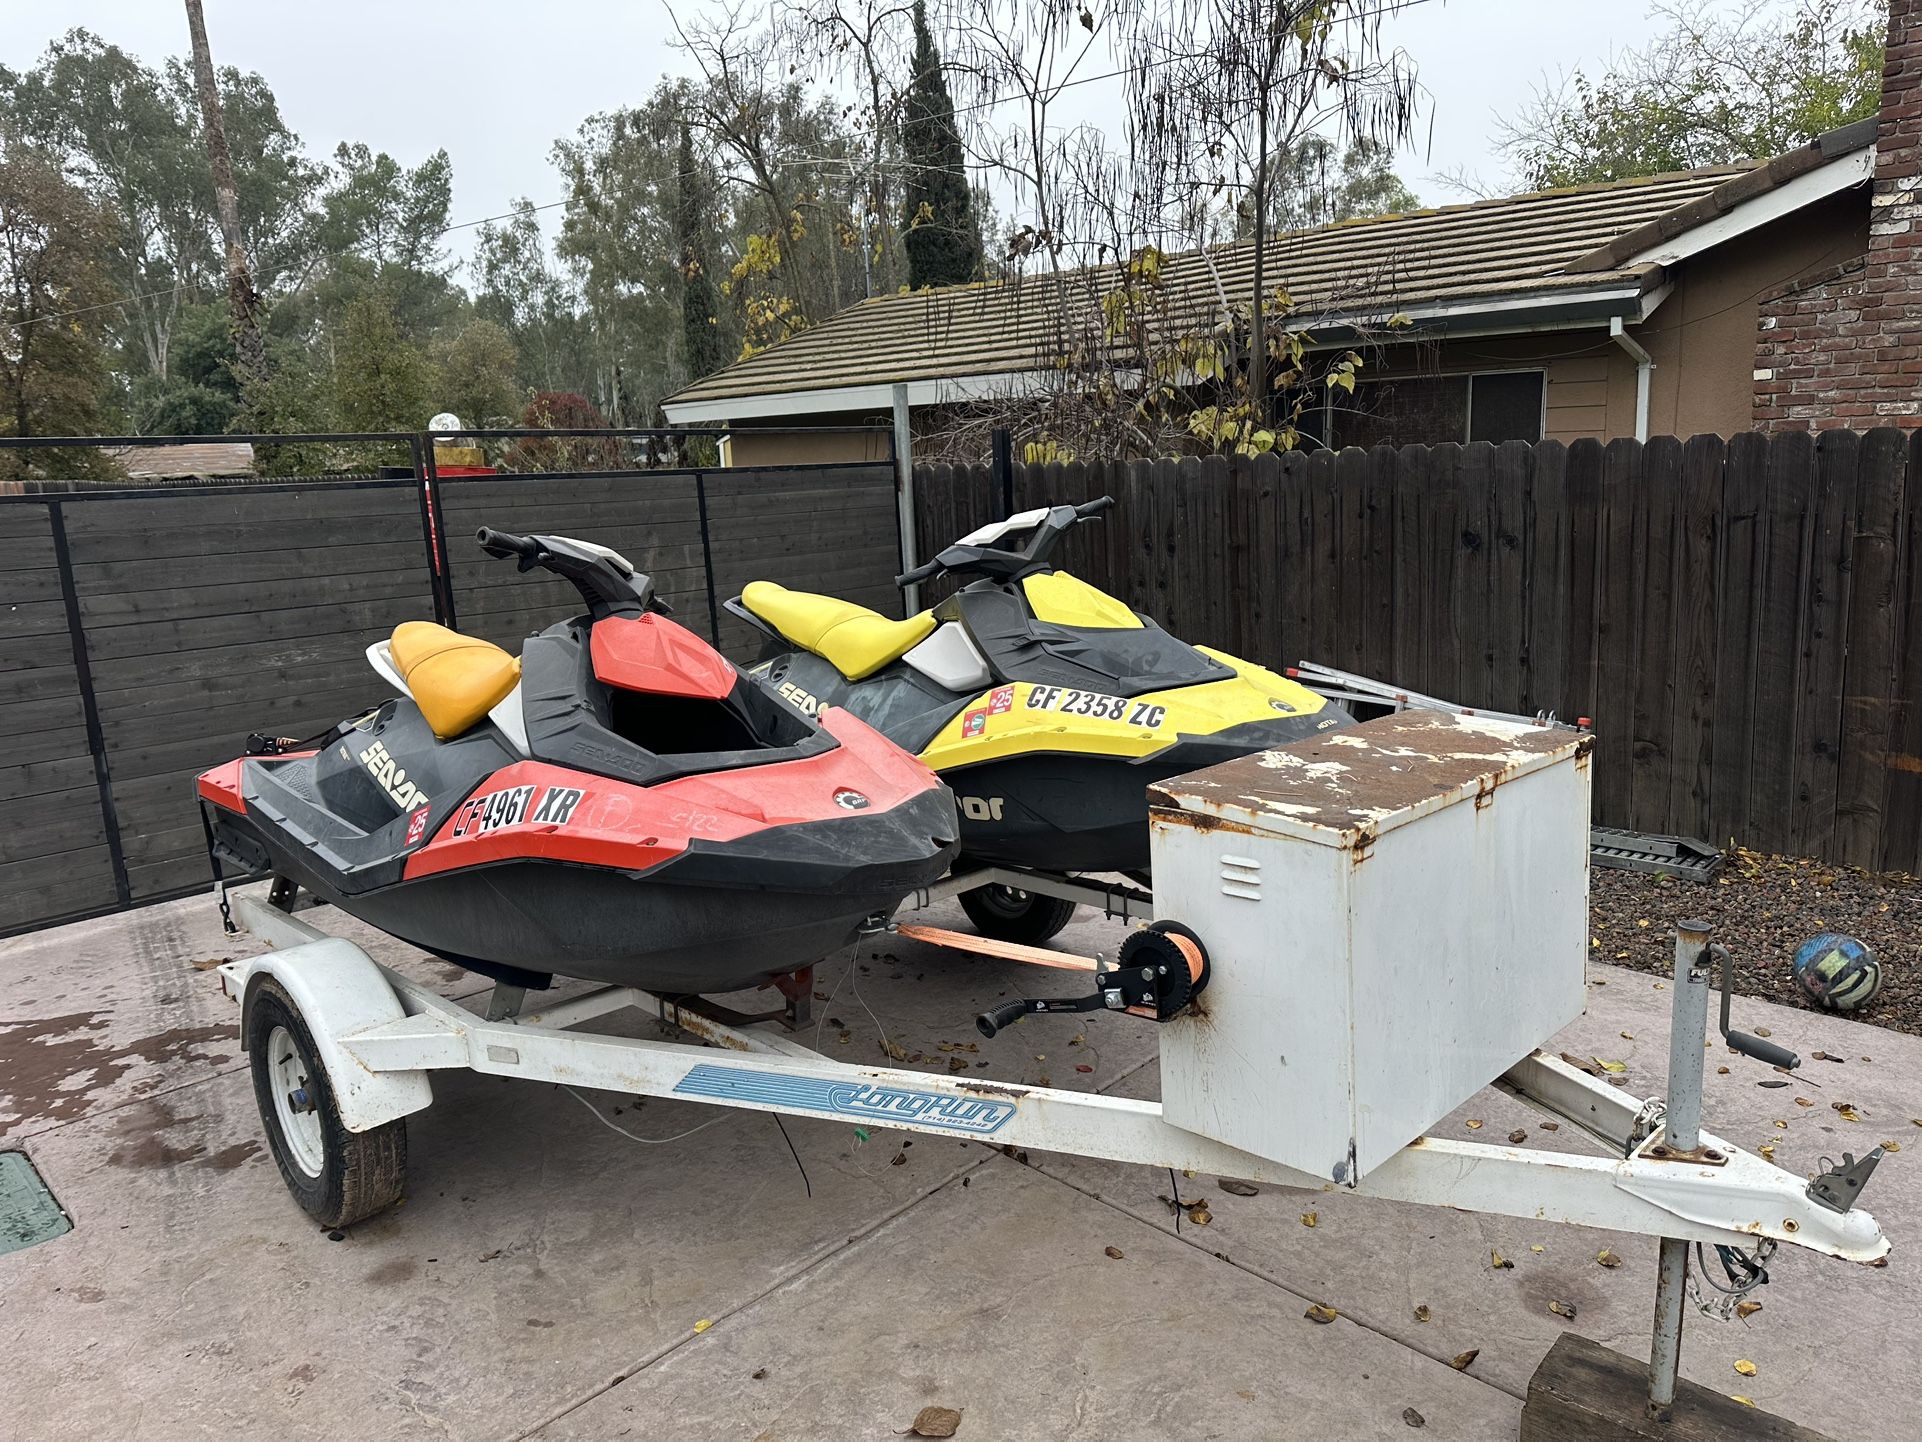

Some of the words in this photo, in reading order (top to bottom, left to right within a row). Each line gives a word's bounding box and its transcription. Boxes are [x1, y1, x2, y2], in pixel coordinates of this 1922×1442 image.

[996, 690, 1014, 708] 25
[1026, 685, 1062, 710] CF
[1060, 690, 1128, 721] 2358
[1129, 702, 1166, 728] ZC
[410, 812, 428, 835] 25
[453, 797, 488, 837] CF
[482, 786, 536, 831] 4961
[533, 787, 581, 823] XR
